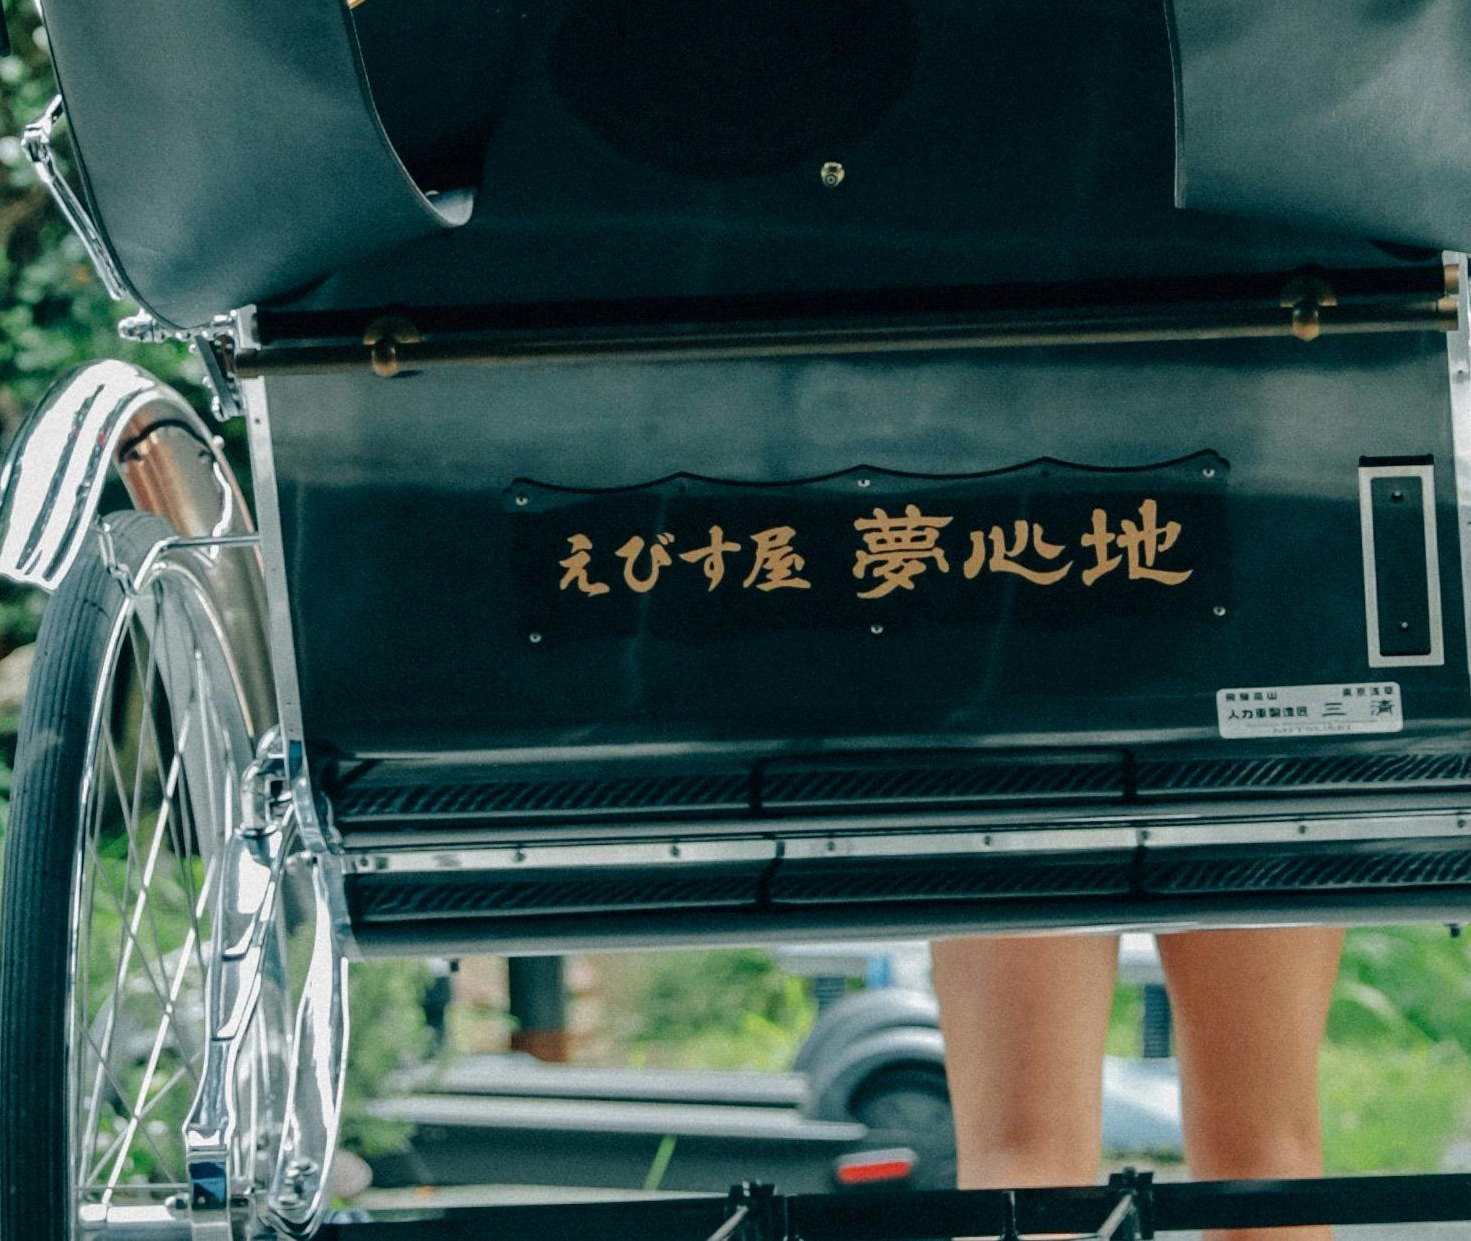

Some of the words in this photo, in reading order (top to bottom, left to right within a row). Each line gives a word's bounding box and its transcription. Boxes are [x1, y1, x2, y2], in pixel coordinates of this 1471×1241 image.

[559, 525, 811, 597] えびす屋
[852, 499, 1193, 599] 夢心地
